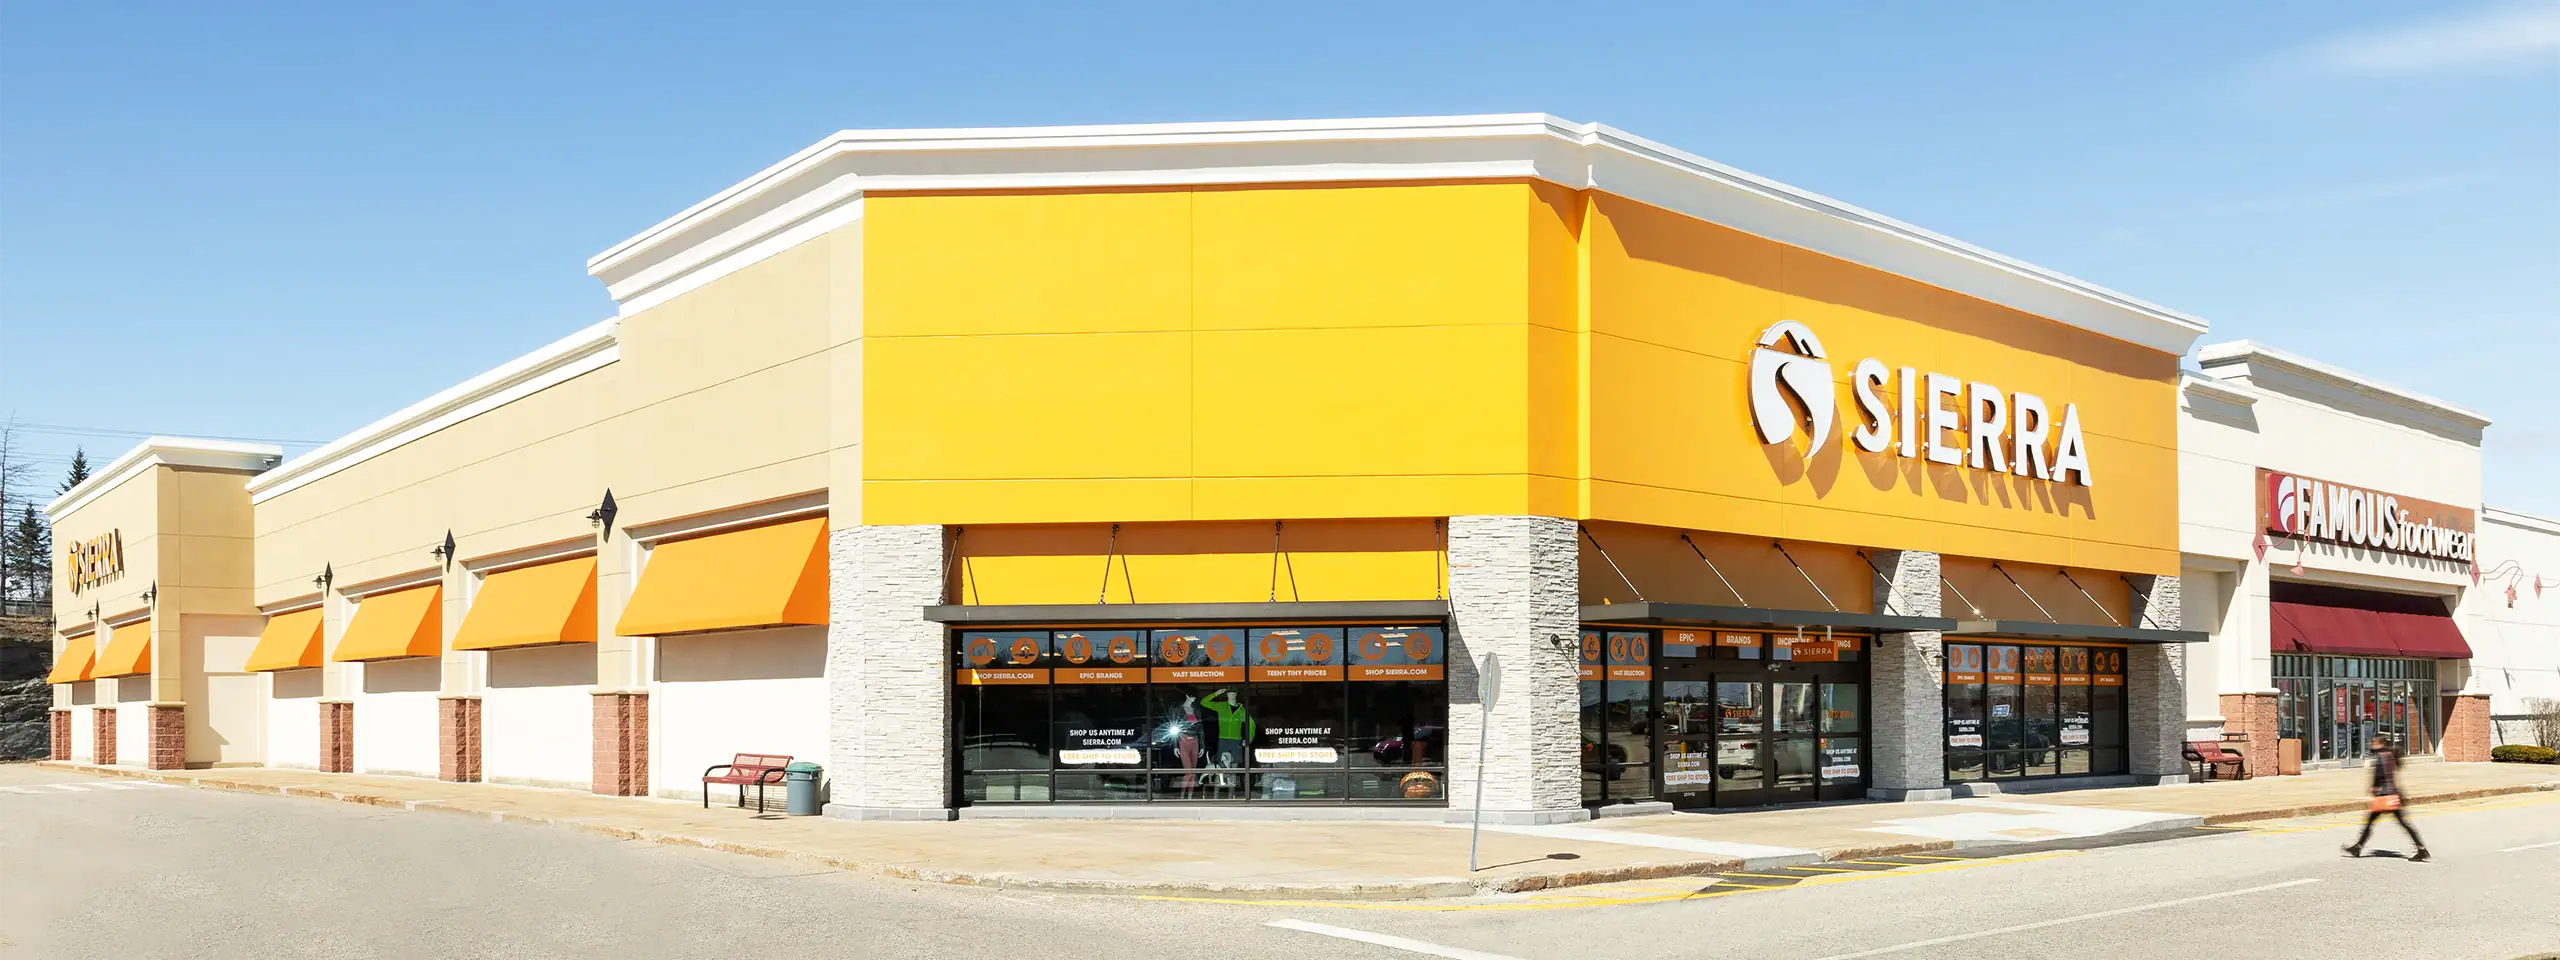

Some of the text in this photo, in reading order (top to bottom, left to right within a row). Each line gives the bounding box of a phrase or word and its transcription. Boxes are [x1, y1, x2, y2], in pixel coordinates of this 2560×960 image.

[1852, 358, 2093, 487] SIERRA
[2296, 477, 2475, 561] FAMOUS footwear
[79, 528, 120, 584] SIERRA
[1679, 633, 1694, 642] EPIC
[1726, 635, 1752, 644] BRANDS
[1803, 648, 1833, 656] SIERRA
[1172, 670, 1224, 678] VAST SELECTION
[1303, 669, 1327, 677] PRICES
[1385, 668, 1427, 676] SIERRA.COM
[1069, 729, 1087, 737] SHOP
[1323, 727, 1331, 735] AT
[1082, 738, 1122, 746] SIERRA.COM
